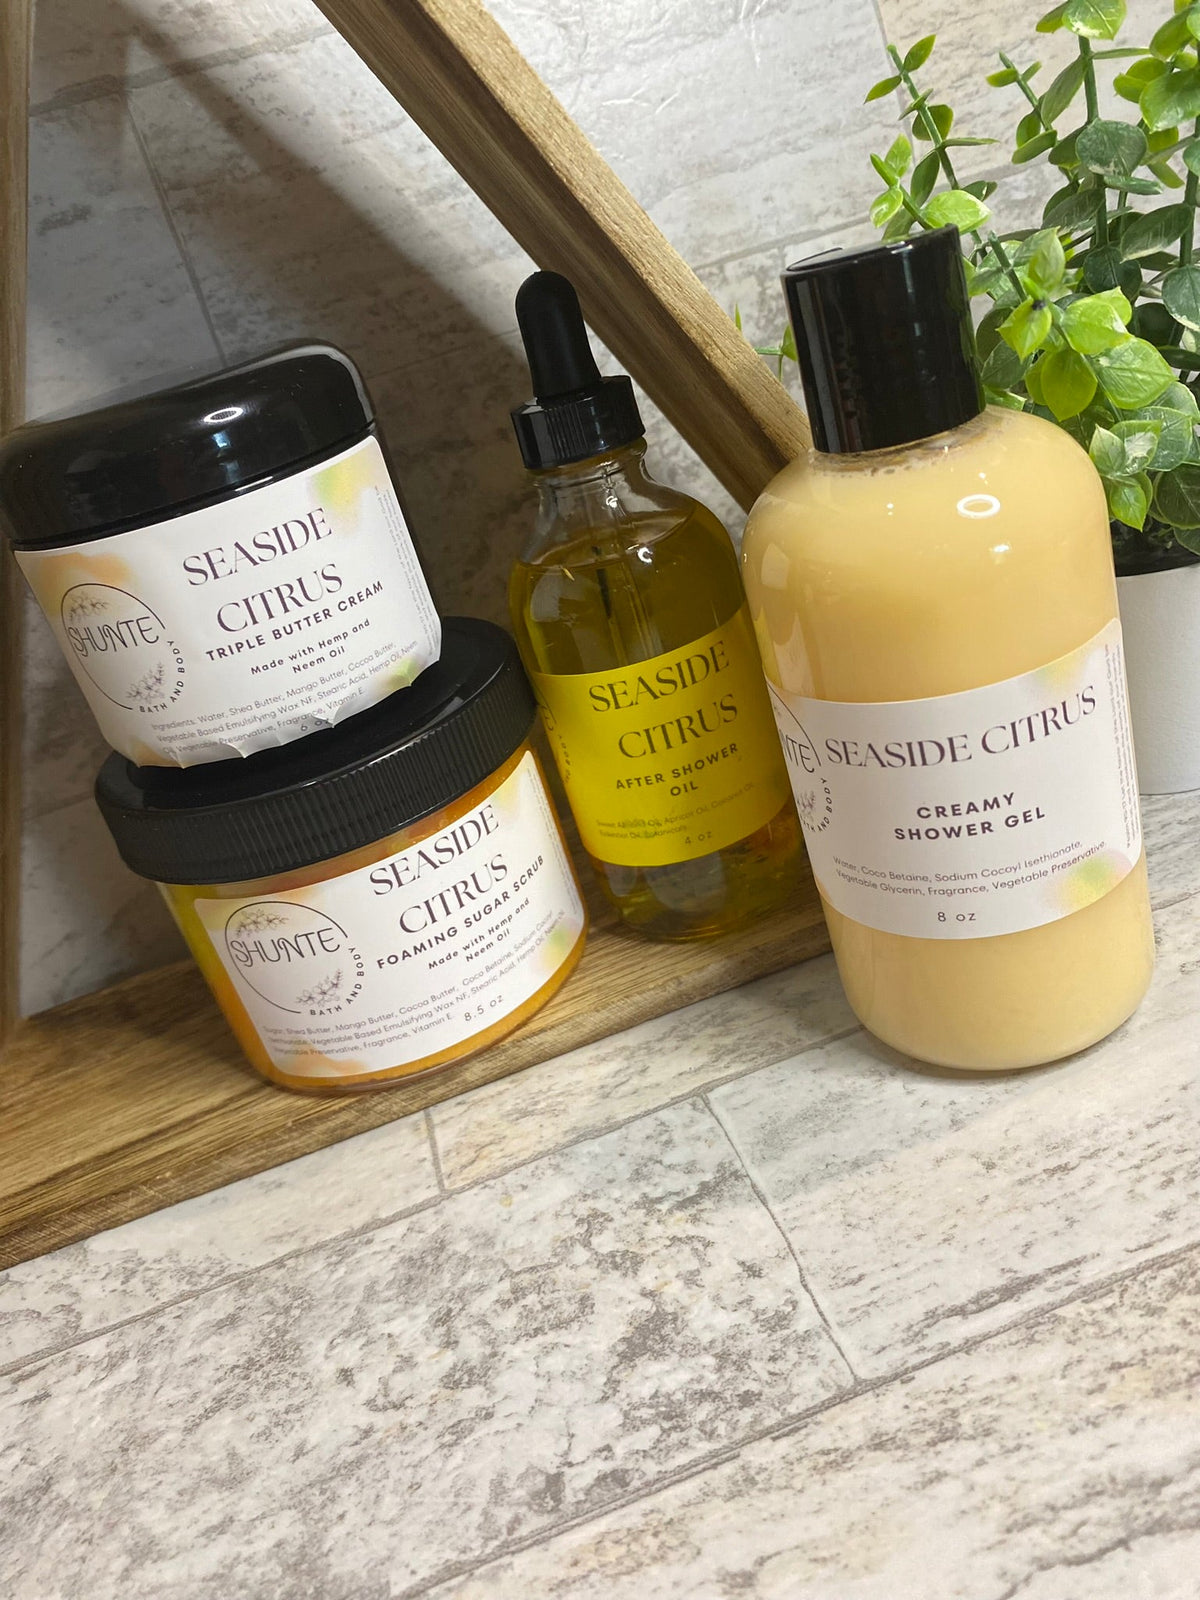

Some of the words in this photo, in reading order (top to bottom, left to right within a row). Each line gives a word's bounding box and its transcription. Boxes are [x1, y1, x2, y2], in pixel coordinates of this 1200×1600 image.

[183, 507, 332, 586] SEASIDE
[216, 563, 342, 632] CITRUS
[68, 616, 160, 658] SHUNTE
[205, 634, 266, 662] TRIPLE
[271, 607, 333, 641] BUTTER
[337, 580, 384, 612] CREAM
[166, 640, 185, 674] BODY
[250, 658, 284, 675] Made
[288, 645, 315, 662] with
[318, 631, 349, 649] Hemp
[351, 618, 371, 633] and
[292, 656, 326, 674] Neem
[329, 645, 345, 658] Oil
[169, 680, 184, 703] AND
[229, 704, 253, 716] Shea
[286, 681, 318, 698] Mango
[347, 655, 374, 672] Cocoa
[588, 640, 730, 713] SEASIDE
[139, 702, 168, 713] BATH
[197, 724, 224, 737] Based
[225, 710, 277, 731] Emulsifying
[277, 702, 299, 714] Wax
[317, 682, 348, 700] Stearic
[369, 660, 391, 676] Hemp
[326, 692, 358, 710] Vitamin
[300, 724, 308, 732] 6
[617, 693, 738, 759] CITRUS
[825, 734, 973, 769] SEASIDE
[981, 685, 1097, 755] CITRUS
[615, 773, 666, 790] AFTER
[671, 743, 739, 779] SHOWER
[670, 781, 699, 797] OIL
[820, 777, 833, 813] BODY
[916, 792, 1015, 820] CREAMY
[697, 831, 713, 842] oz
[894, 820, 994, 841] SHOWER
[1004, 806, 1046, 828] GEL
[369, 804, 499, 895] SEASIDE
[861, 865, 887, 879] Coco
[889, 871, 932, 883] Betaine,
[934, 869, 978, 882] Sodium
[981, 862, 1022, 878] Cocoyl
[1024, 840, 1083, 868] Isethionate,
[399, 853, 508, 933] CITRUS
[835, 868, 878, 890] Vegetable
[879, 882, 926, 897] Glycerin,
[927, 884, 989, 897] Fragrance,
[992, 869, 1049, 890] Vegetable
[376, 926, 458, 970] FOAMING
[464, 891, 510, 928] SUGAR
[513, 855, 544, 892] SCRUB
[937, 911, 946, 923] 8
[955, 912, 976, 922] oz
[230, 927, 340, 968] SHUNTE
[428, 950, 459, 970] Made
[462, 934, 486, 951] with
[487, 914, 513, 935] Hemp
[514, 897, 530, 914] and
[465, 941, 494, 962] Neem
[496, 928, 510, 942] Oil
[348, 946, 365, 977] BODY
[310, 1005, 342, 1016] BATH
[335, 1020, 367, 1032] Mango
[367, 1011, 398, 1025] Butter,
[399, 999, 429, 1015] Cocoa
[430, 985, 460, 1002] Butter,
[462, 971, 484, 986] Coco
[345, 983, 362, 1004] AND
[353, 1028, 382, 1040] Based
[383, 1010, 433, 1032] Emulsifying
[433, 1001, 455, 1013] Wax
[470, 975, 498, 994] Stearic
[463, 1004, 485, 1022] 8.5
[489, 994, 504, 1008] oz
[411, 1018, 445, 1034] Vitamin
